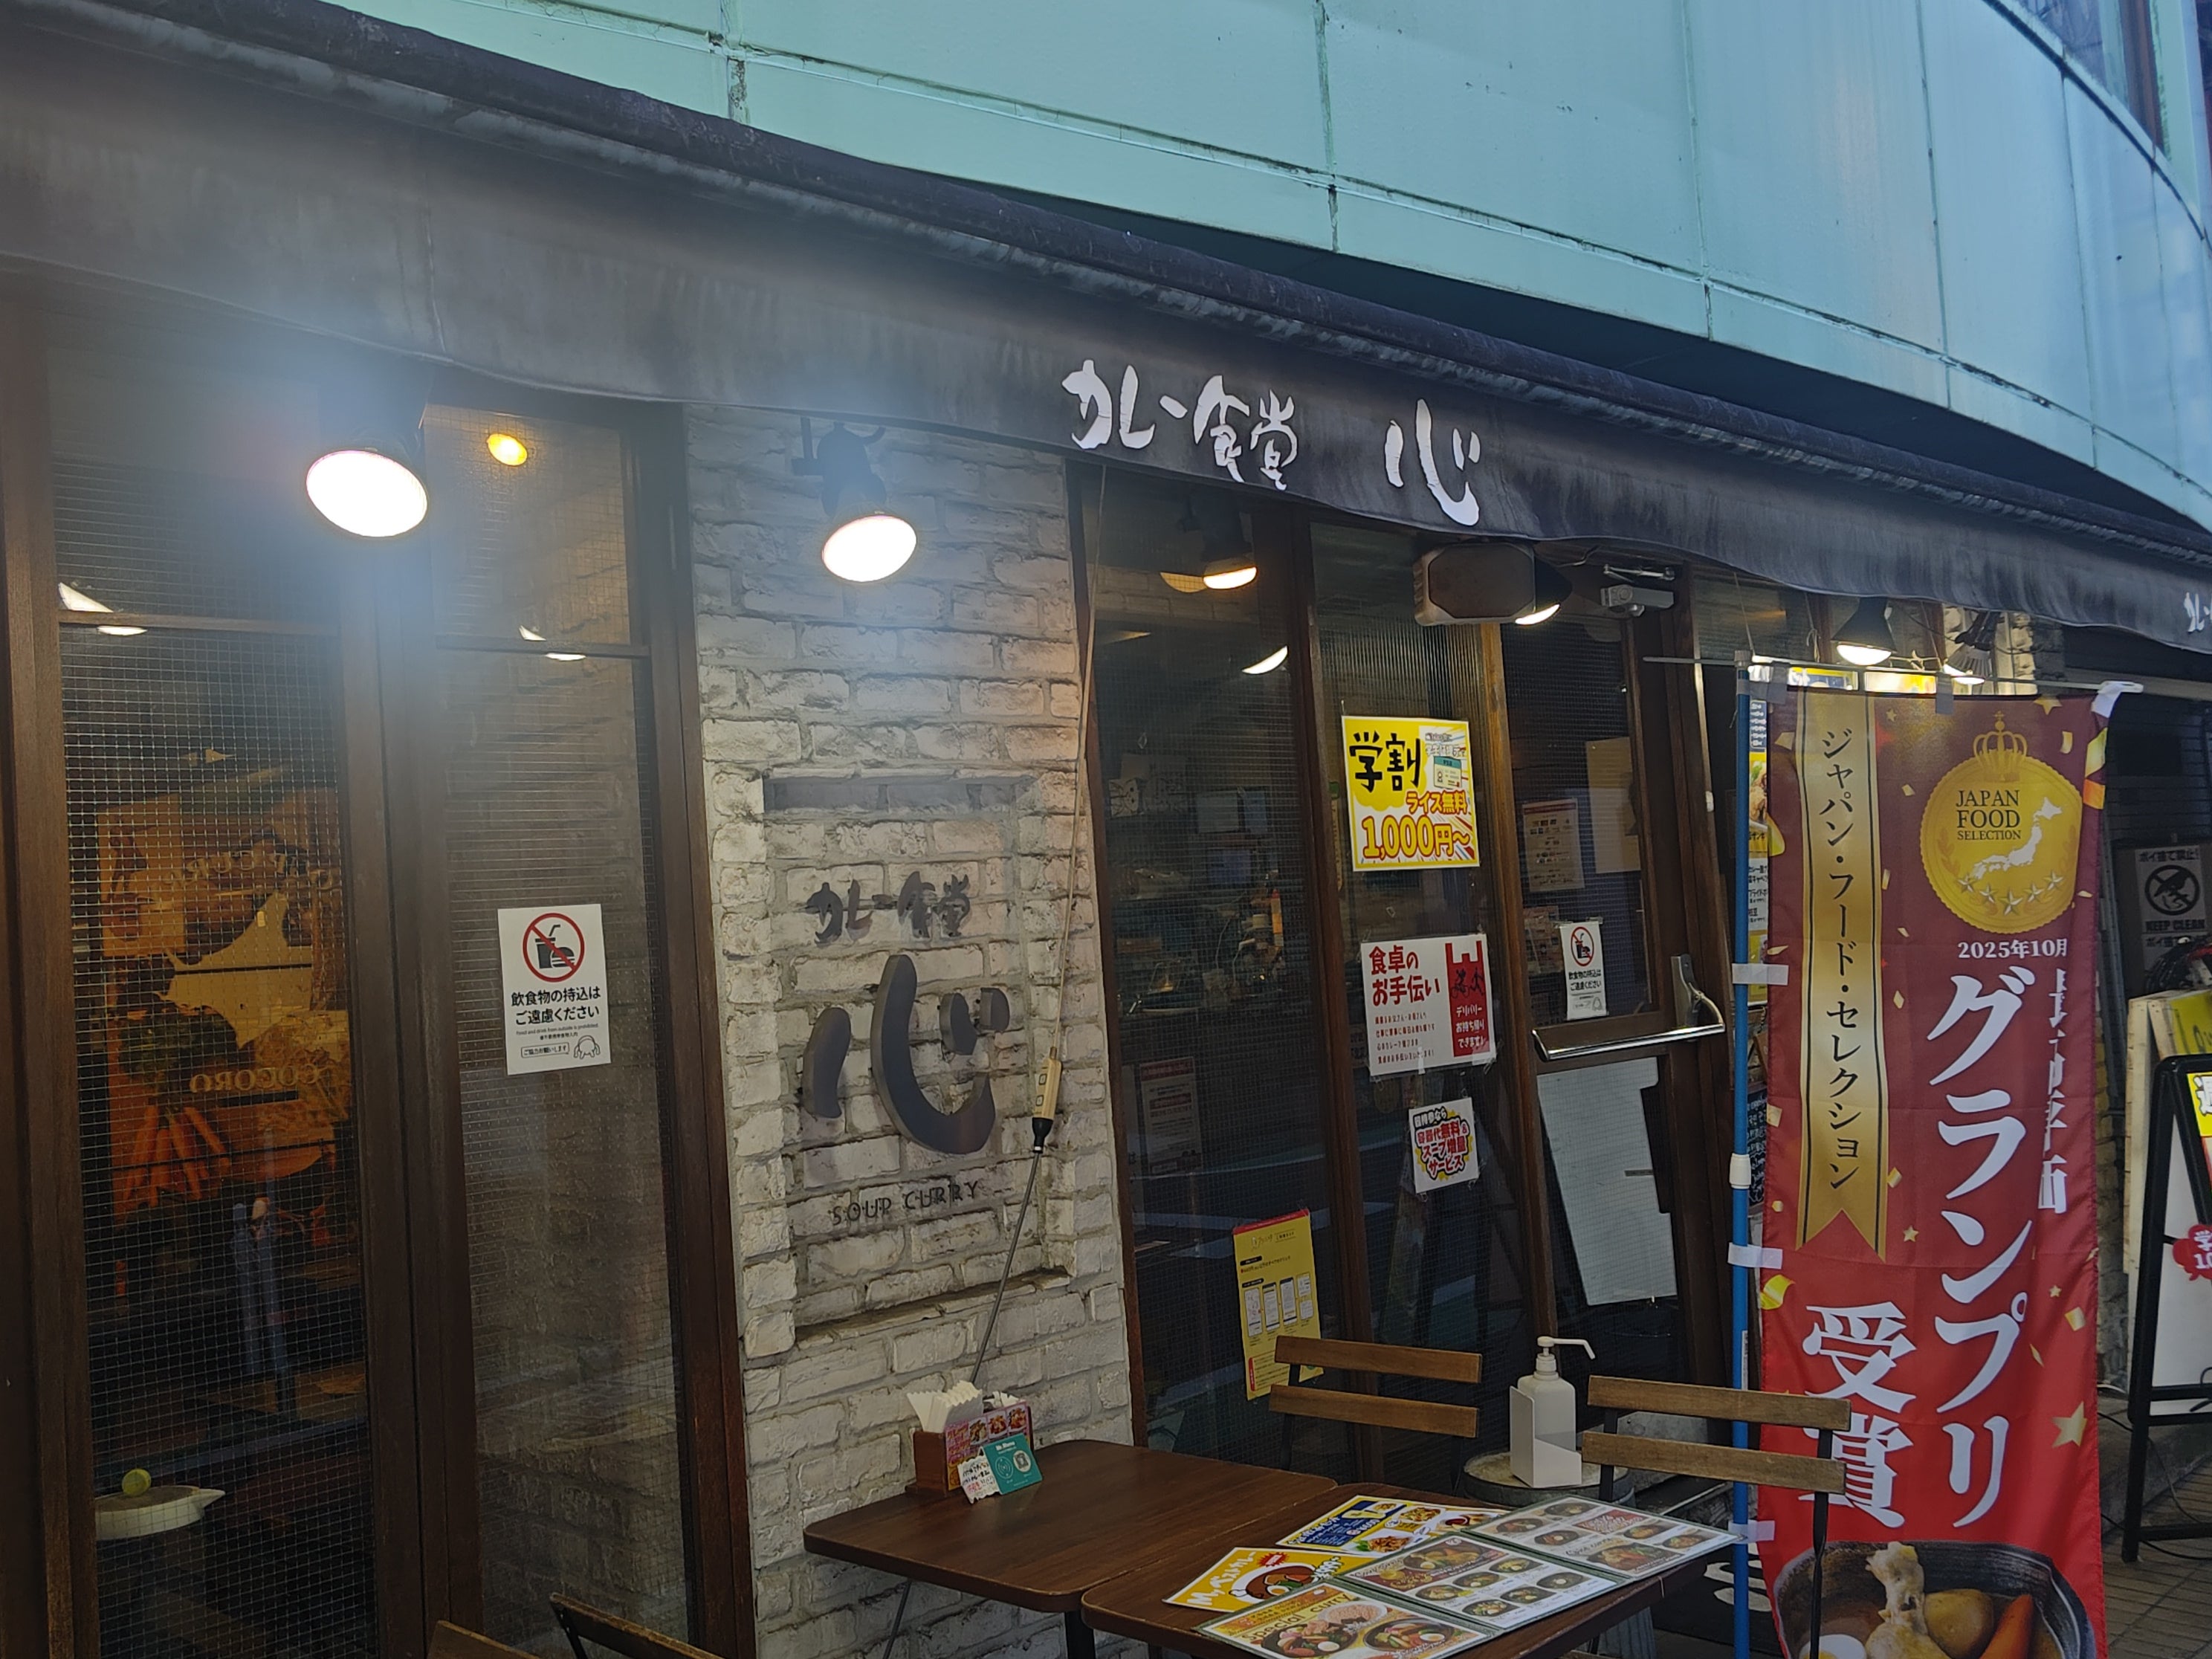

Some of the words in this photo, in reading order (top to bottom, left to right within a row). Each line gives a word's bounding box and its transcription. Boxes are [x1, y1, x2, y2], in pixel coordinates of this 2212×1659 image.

[1062, 360, 1299, 491] カレー食堂
[1384, 399, 1481, 526] 心
[2184, 592, 2212, 633] カレー
[1349, 731, 1421, 792] 学割
[1406, 790, 1468, 814] ライス無料
[1956, 789, 2019, 807] JAPAN
[1956, 809, 2020, 828] FOOD
[1957, 830, 2022, 841] SELECTION
[806, 871, 971, 945] カレー食堂
[1369, 945, 1419, 975] 食卓の
[1820, 728, 1860, 1190] ジャパン・フード・セレクション
[1958, 939, 2068, 959] 2025年10月
[511, 986, 601, 1006] 飲食物の持込は
[1372, 974, 1440, 1006] お手伝い
[516, 1006, 600, 1025] ご遠慮ください
[802, 954, 1010, 1154] 心
[1429, 1156, 1463, 1176] サービス
[833, 1196, 892, 1226] SOUP
[904, 1180, 979, 1212] CURRY
[1927, 966, 2037, 1530] グランプリ
[1799, 1301, 1915, 1530] 受賞
[1242, 1614, 1305, 1640] Special
[1310, 1594, 1351, 1613] curry
